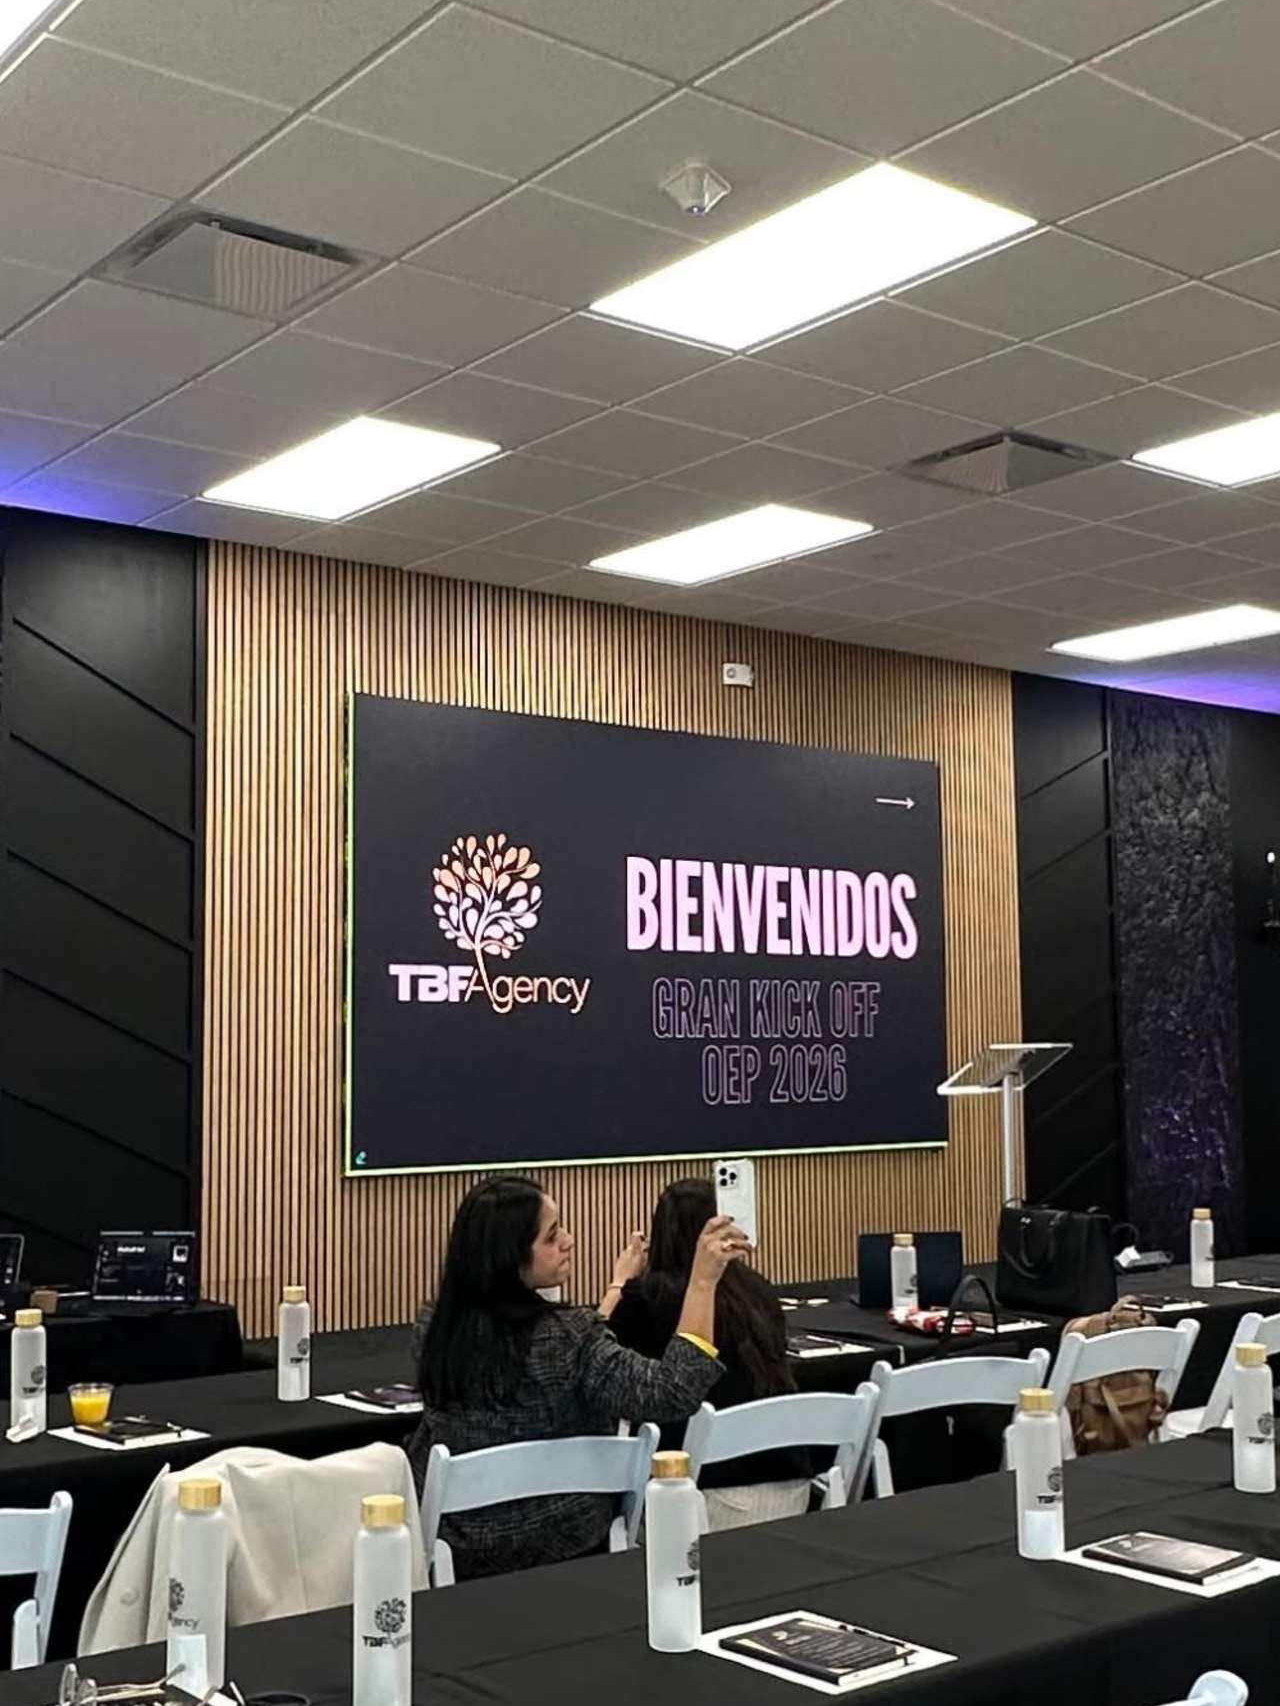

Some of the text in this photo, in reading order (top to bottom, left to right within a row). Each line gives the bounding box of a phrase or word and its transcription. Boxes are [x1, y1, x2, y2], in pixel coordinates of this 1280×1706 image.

[626, 855, 919, 960] BIENVENIDOS
[388, 964, 592, 1014] TBFAgency
[652, 977, 881, 1039] GRAN KICK OFF
[701, 1043, 847, 1105] OEP 2026
